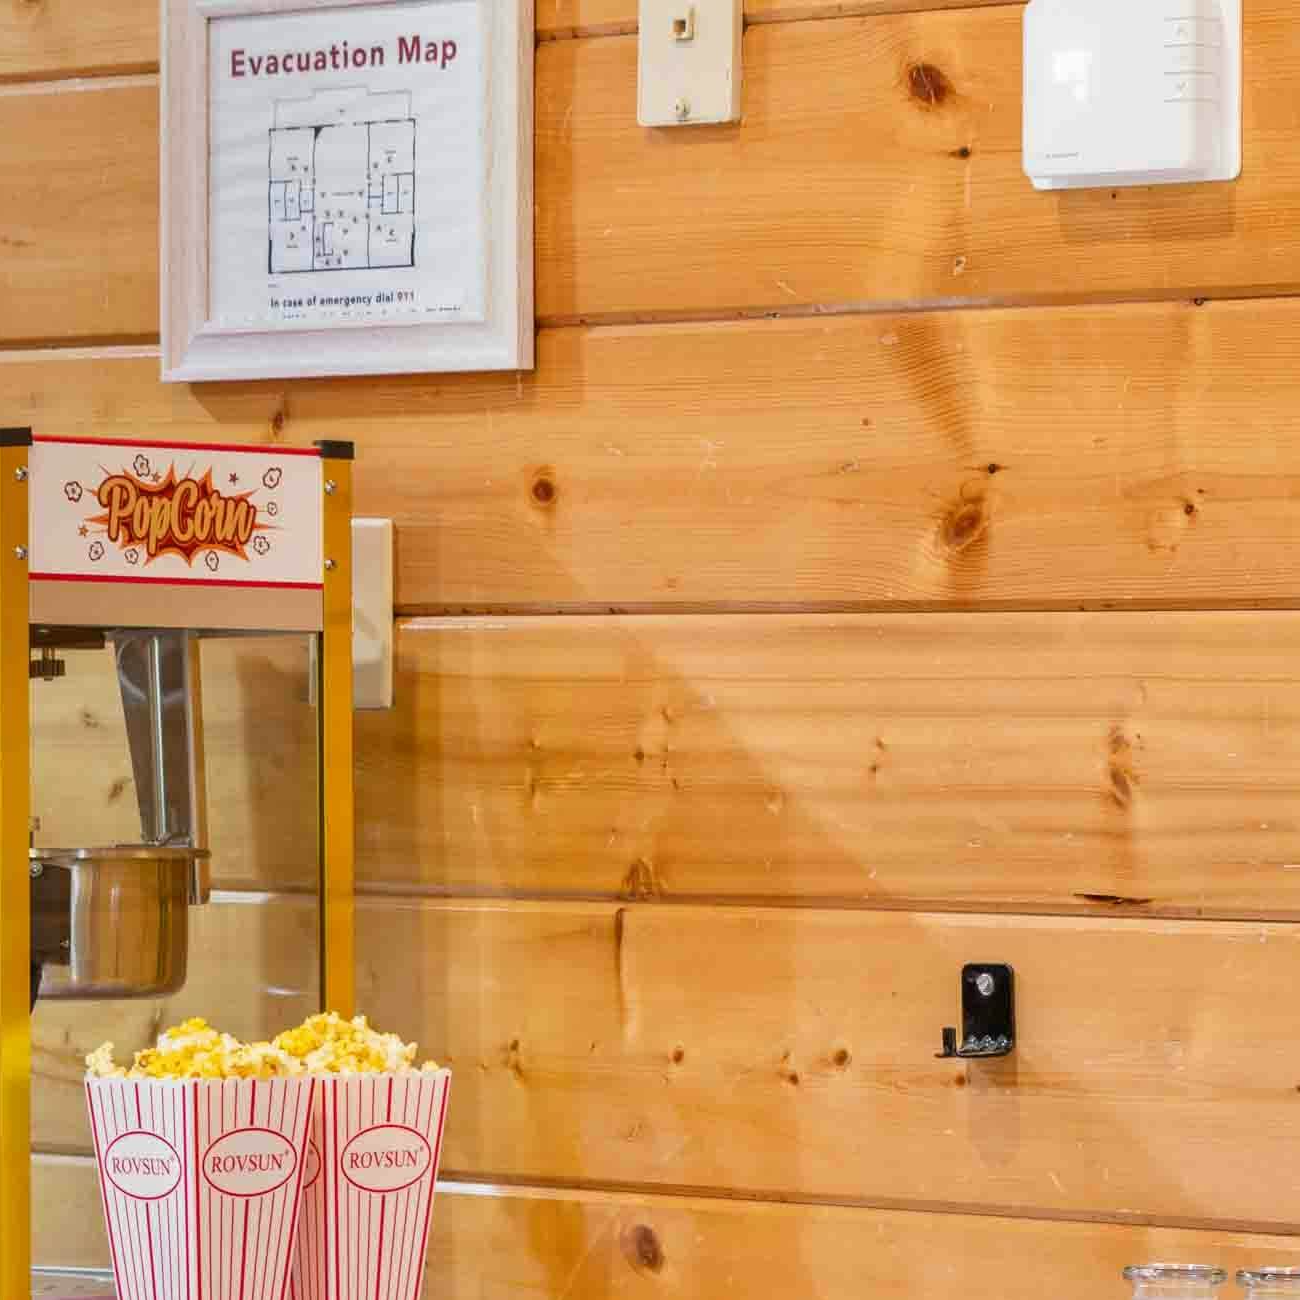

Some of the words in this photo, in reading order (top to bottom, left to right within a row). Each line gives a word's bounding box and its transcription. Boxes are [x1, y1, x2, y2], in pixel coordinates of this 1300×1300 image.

[231, 40, 384, 78] Evacuation
[397, 35, 458, 70] Map
[283, 299, 303, 308] case
[307, 296, 317, 307] of
[319, 296, 373, 308] emergency
[375, 292, 394, 304] dial
[397, 290, 415, 302] 911
[96, 474, 257, 558] PopCorn
[111, 1156, 172, 1177] ROVSUN
[211, 1152, 285, 1174] ROVSUN
[349, 1149, 419, 1170] ROVSUN
